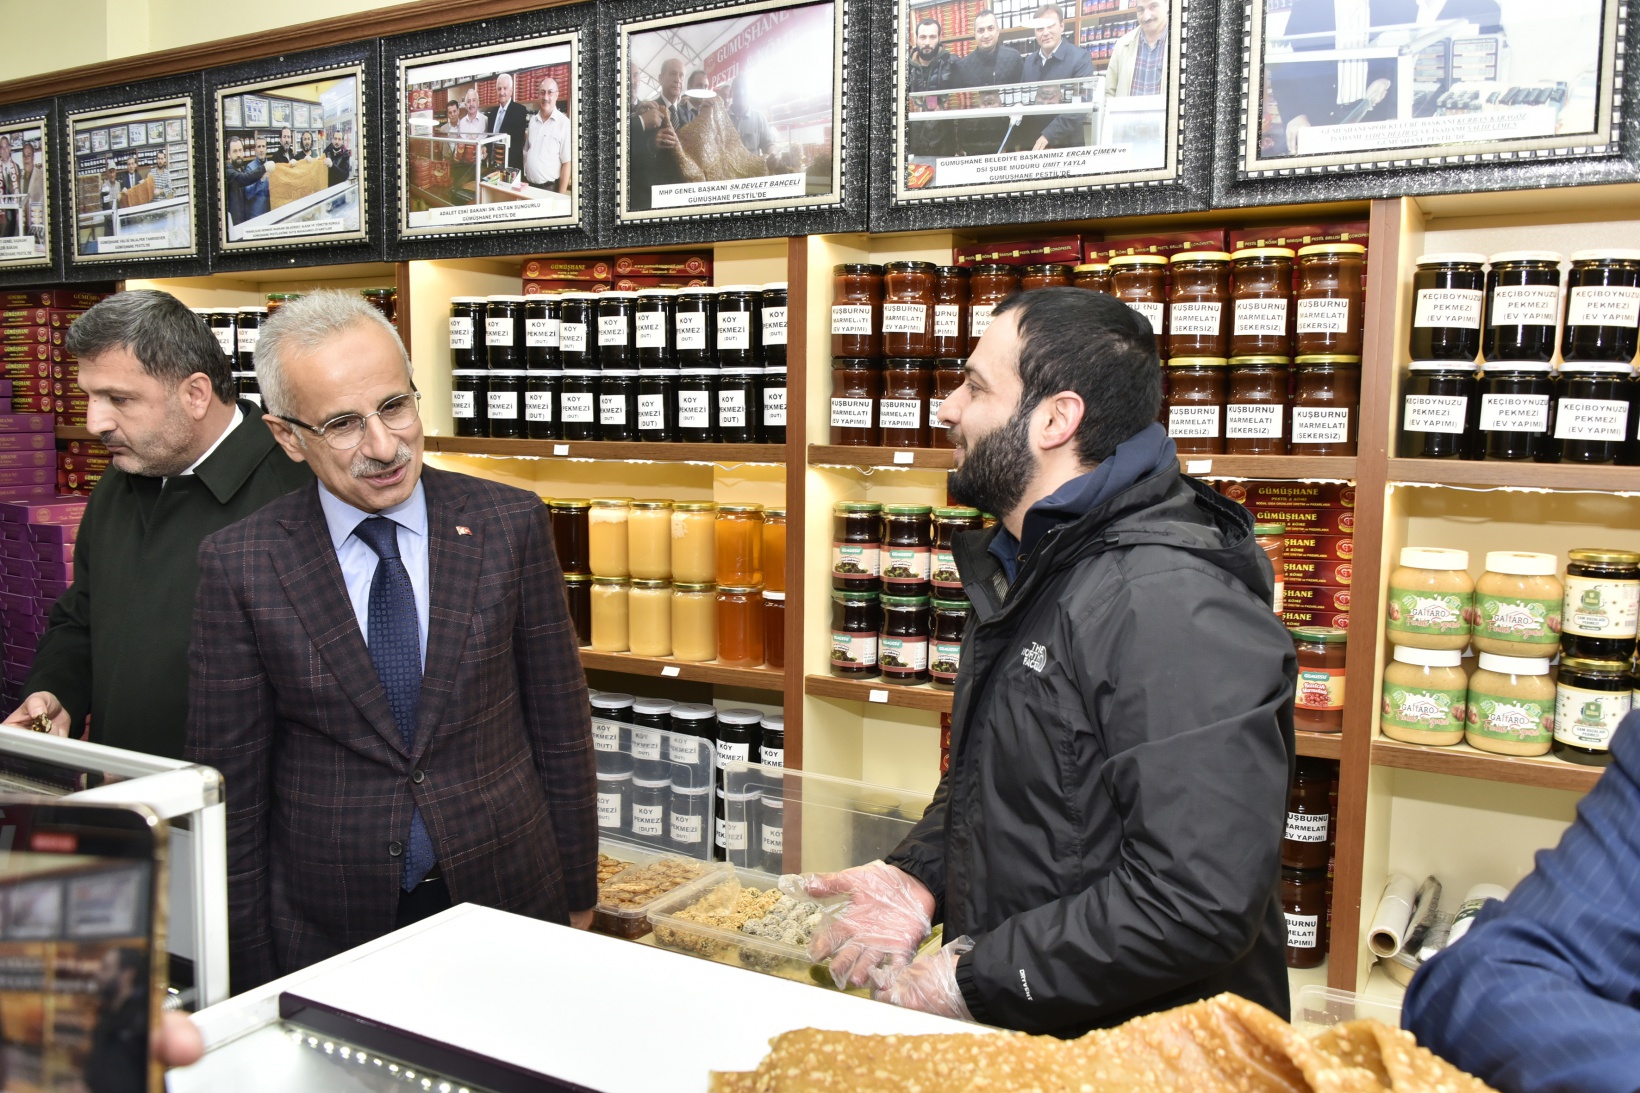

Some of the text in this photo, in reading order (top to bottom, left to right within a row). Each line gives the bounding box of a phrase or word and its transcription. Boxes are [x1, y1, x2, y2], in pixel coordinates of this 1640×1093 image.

[940, 158, 983, 166] GÜMÜŞHANE
[985, 154, 1018, 163] BELEDİYE
[1020, 151, 1064, 160] BAŞKANIMIZ
[989, 170, 1070, 180] GÜMÜŞHANE PESTİL'DE
[698, 185, 728, 193] BAŞKANI
[729, 182, 768, 191] SN.DEVLET
[769, 178, 800, 187] BAHÇELİ
[688, 194, 730, 203] GÜMÜŞHANE
[1422, 293, 1481, 301] KEÇİBOYNUZU
[1496, 290, 1556, 298] KEÇİBOYNUZU
[1173, 304, 1219, 312] KUŞBURNU
[1299, 301, 1347, 309] KUŞBURNU
[1446, 315, 1476, 324] YAPIMI)
[1298, 322, 1339, 330] (ŞEKERSİZ)
[1406, 398, 1462, 406] KEÇİBOYNUZU
[1170, 408, 1215, 416] KUŞBURNU
[1229, 406, 1275, 414] KUŞBURNU
[1564, 404, 1627, 413] KEÇİBOYNUZU
[1298, 411, 1347, 419] KUŞBURNU
[1423, 420, 1457, 428] YAPIMI)
[1297, 432, 1340, 440] (ŞEKERSİZ)
[1588, 428, 1621, 436] YAPIMI)
[1258, 487, 1319, 496] GÜMÜŞHANE
[1257, 511, 1317, 521] GÜMÜŞHANE
[1284, 538, 1316, 546] ŞHANE
[1288, 814, 1328, 823] UŞBURNU
[1286, 918, 1316, 927] BURNU
